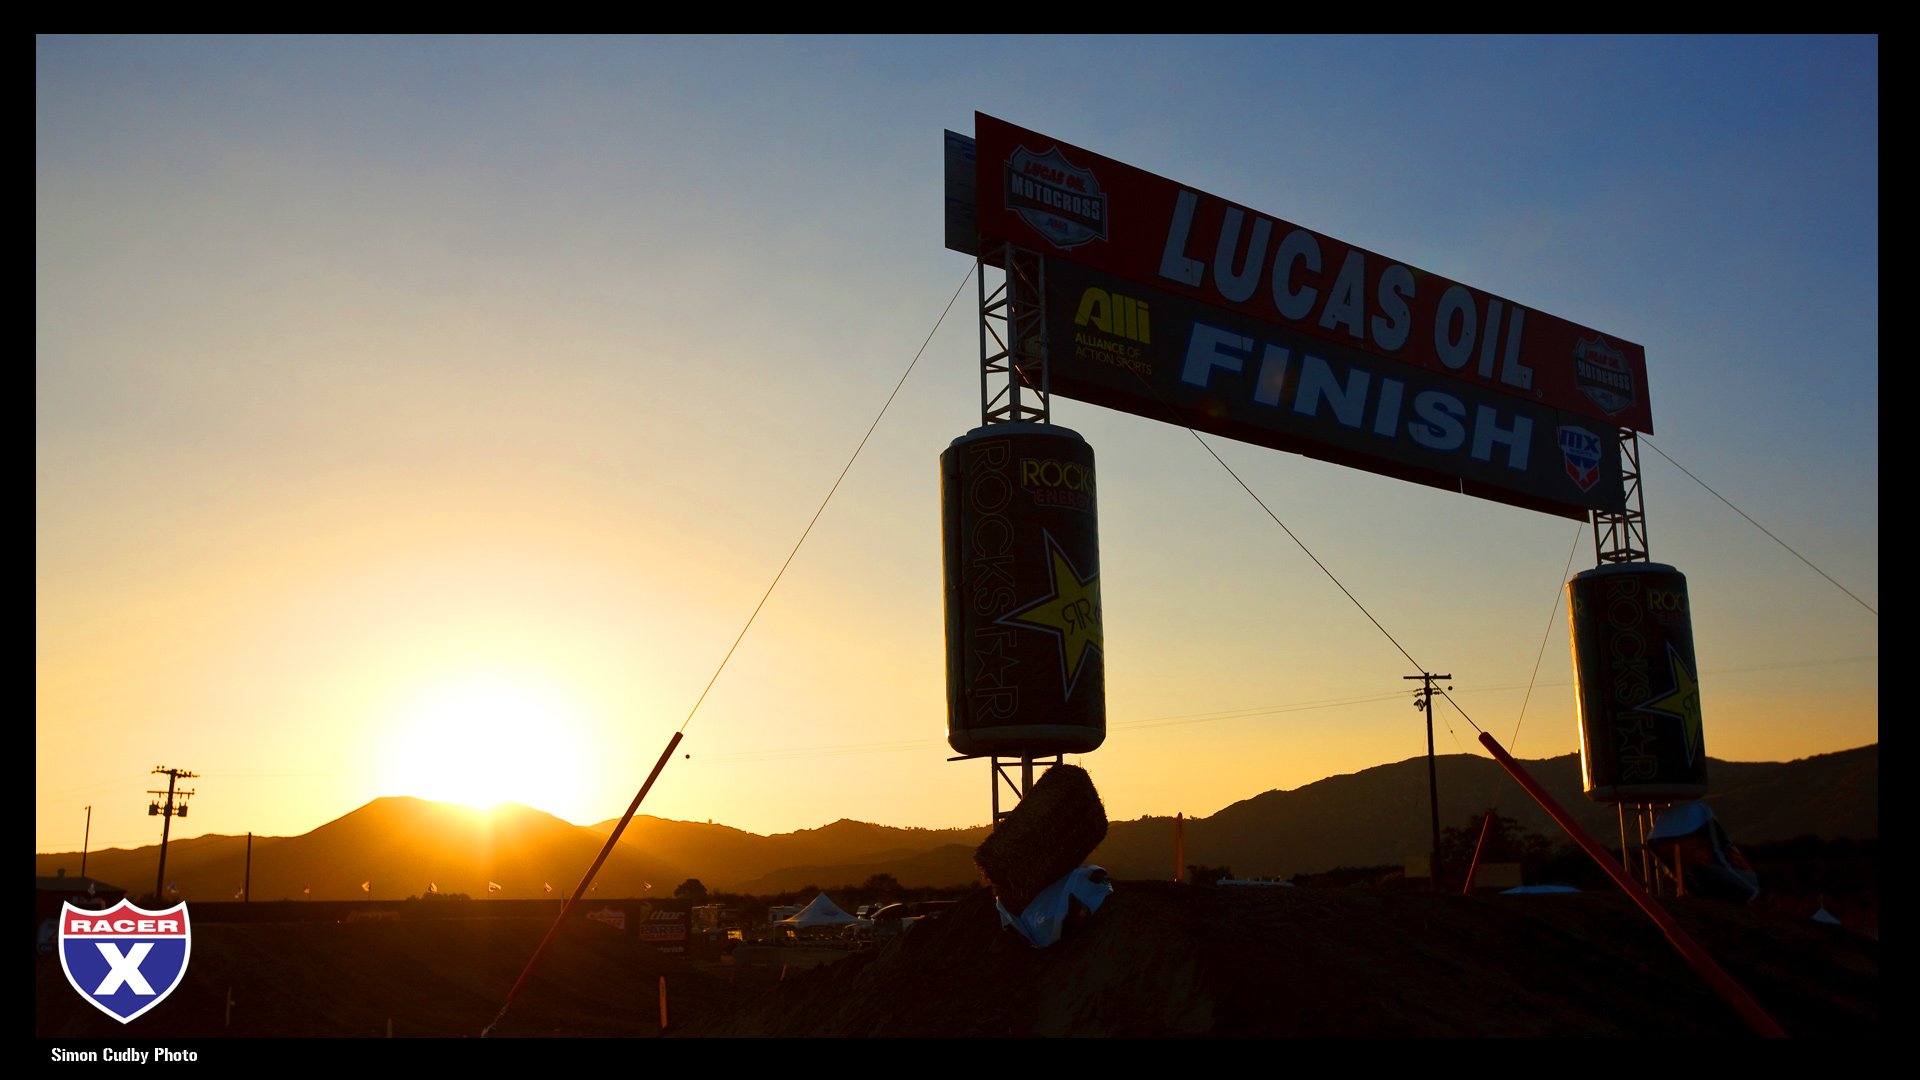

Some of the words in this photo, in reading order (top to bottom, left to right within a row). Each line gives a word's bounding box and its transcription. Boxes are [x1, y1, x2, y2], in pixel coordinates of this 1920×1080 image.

[1011, 172, 1101, 222] MOTOCROSS
[1158, 188, 1417, 352] LUCAS
[1433, 284, 1534, 391] OIL
[1075, 332, 1126, 356] ALLIANCE
[1127, 345, 1141, 360] OF
[1076, 345, 1116, 365] ACTION
[1116, 357, 1152, 376] SPORTS
[1179, 319, 1535, 472] FINISH
[650, 909, 686, 920] thor
